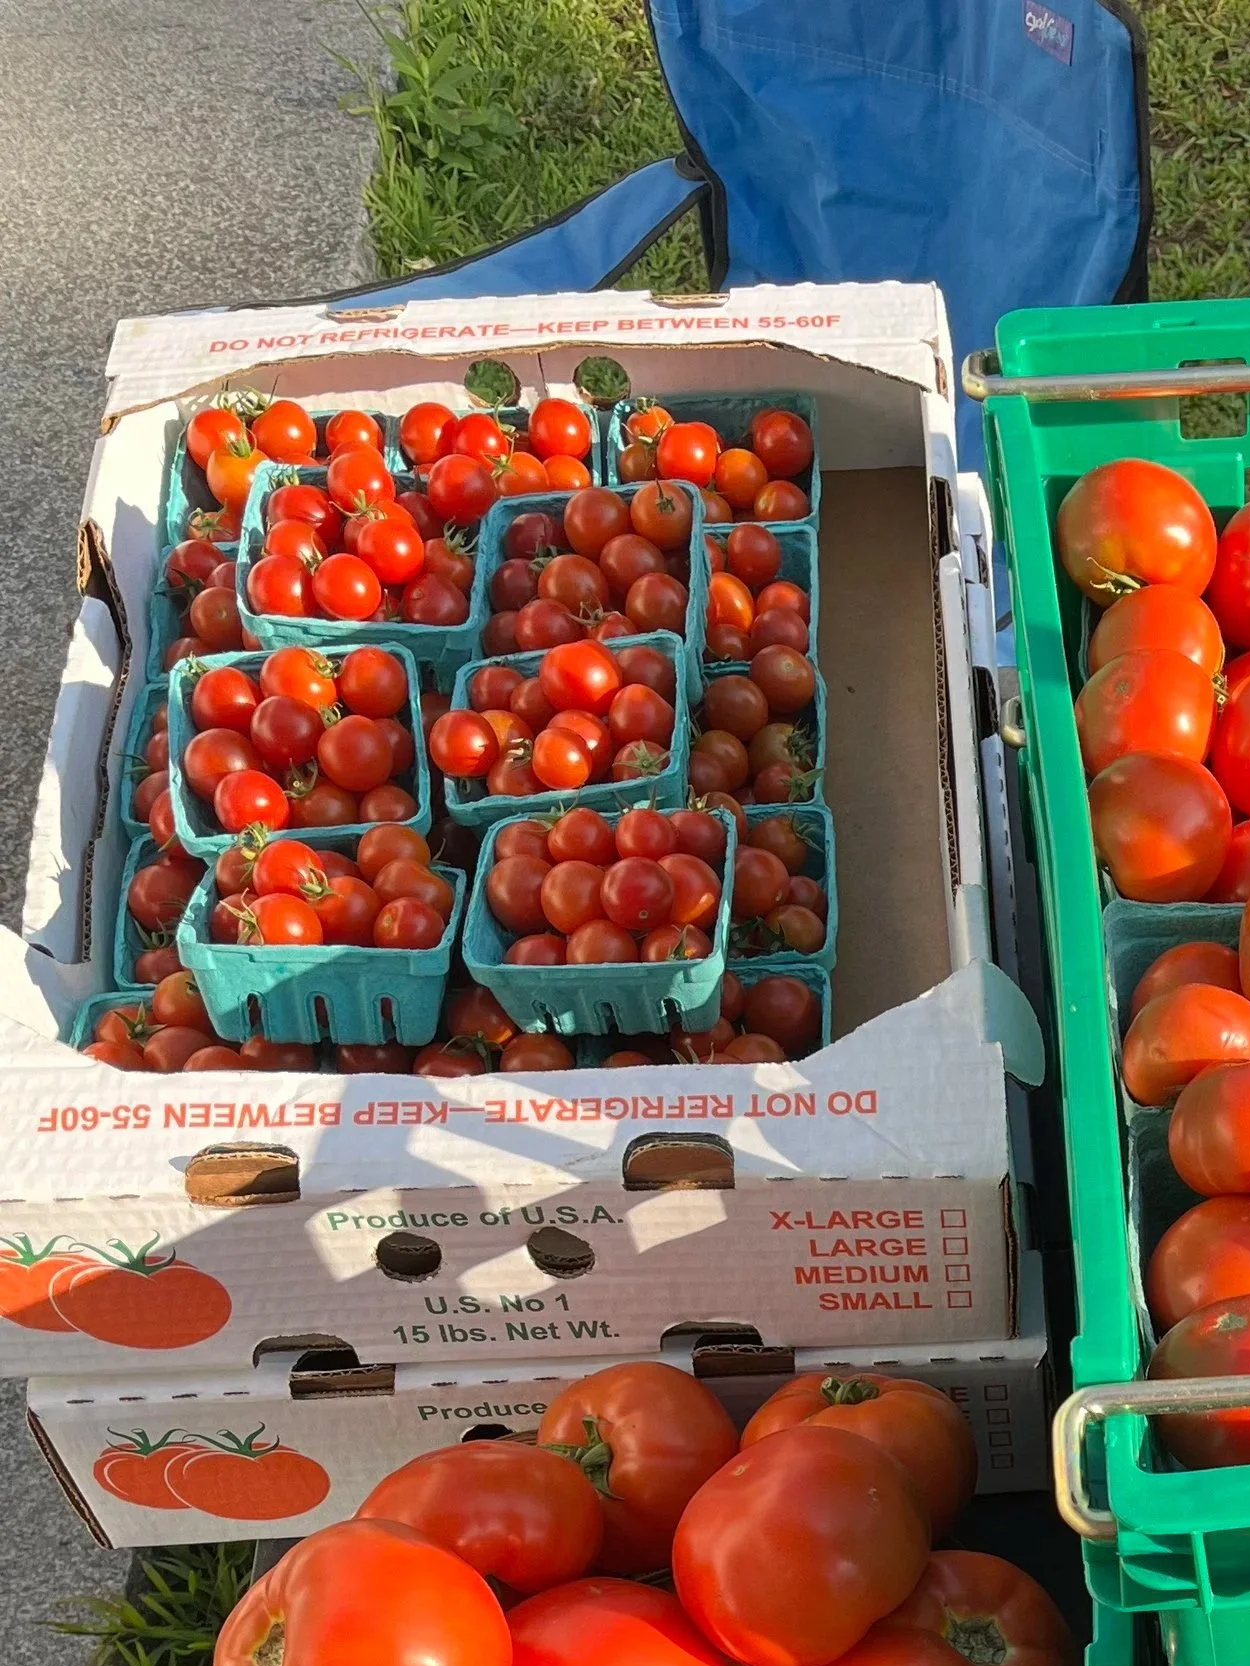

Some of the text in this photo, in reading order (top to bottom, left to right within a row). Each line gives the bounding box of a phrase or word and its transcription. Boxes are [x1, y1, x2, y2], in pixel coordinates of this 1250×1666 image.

[209, 339, 249, 353] DO
[257, 334, 312, 349] NOT
[617, 316, 749, 332] BETWEEN
[758, 314, 841, 329] 55-60F
[745, 1092, 816, 1118] NOT
[828, 1090, 878, 1116] DO
[37, 1103, 151, 1133] 55-60F
[163, 1102, 341, 1130] BETWEEN
[327, 1205, 624, 1231] Produce of U.S.A.
[769, 1208, 925, 1231] X-LARGE
[807, 1237, 927, 1258] LARGE
[794, 1264, 930, 1285] MEDIUM
[424, 1293, 570, 1315] U.S. No 1
[818, 1290, 933, 1311] SMALL
[393, 1319, 620, 1344] 15 lbs. Net Wt.
[417, 1402, 548, 1421] Produce
